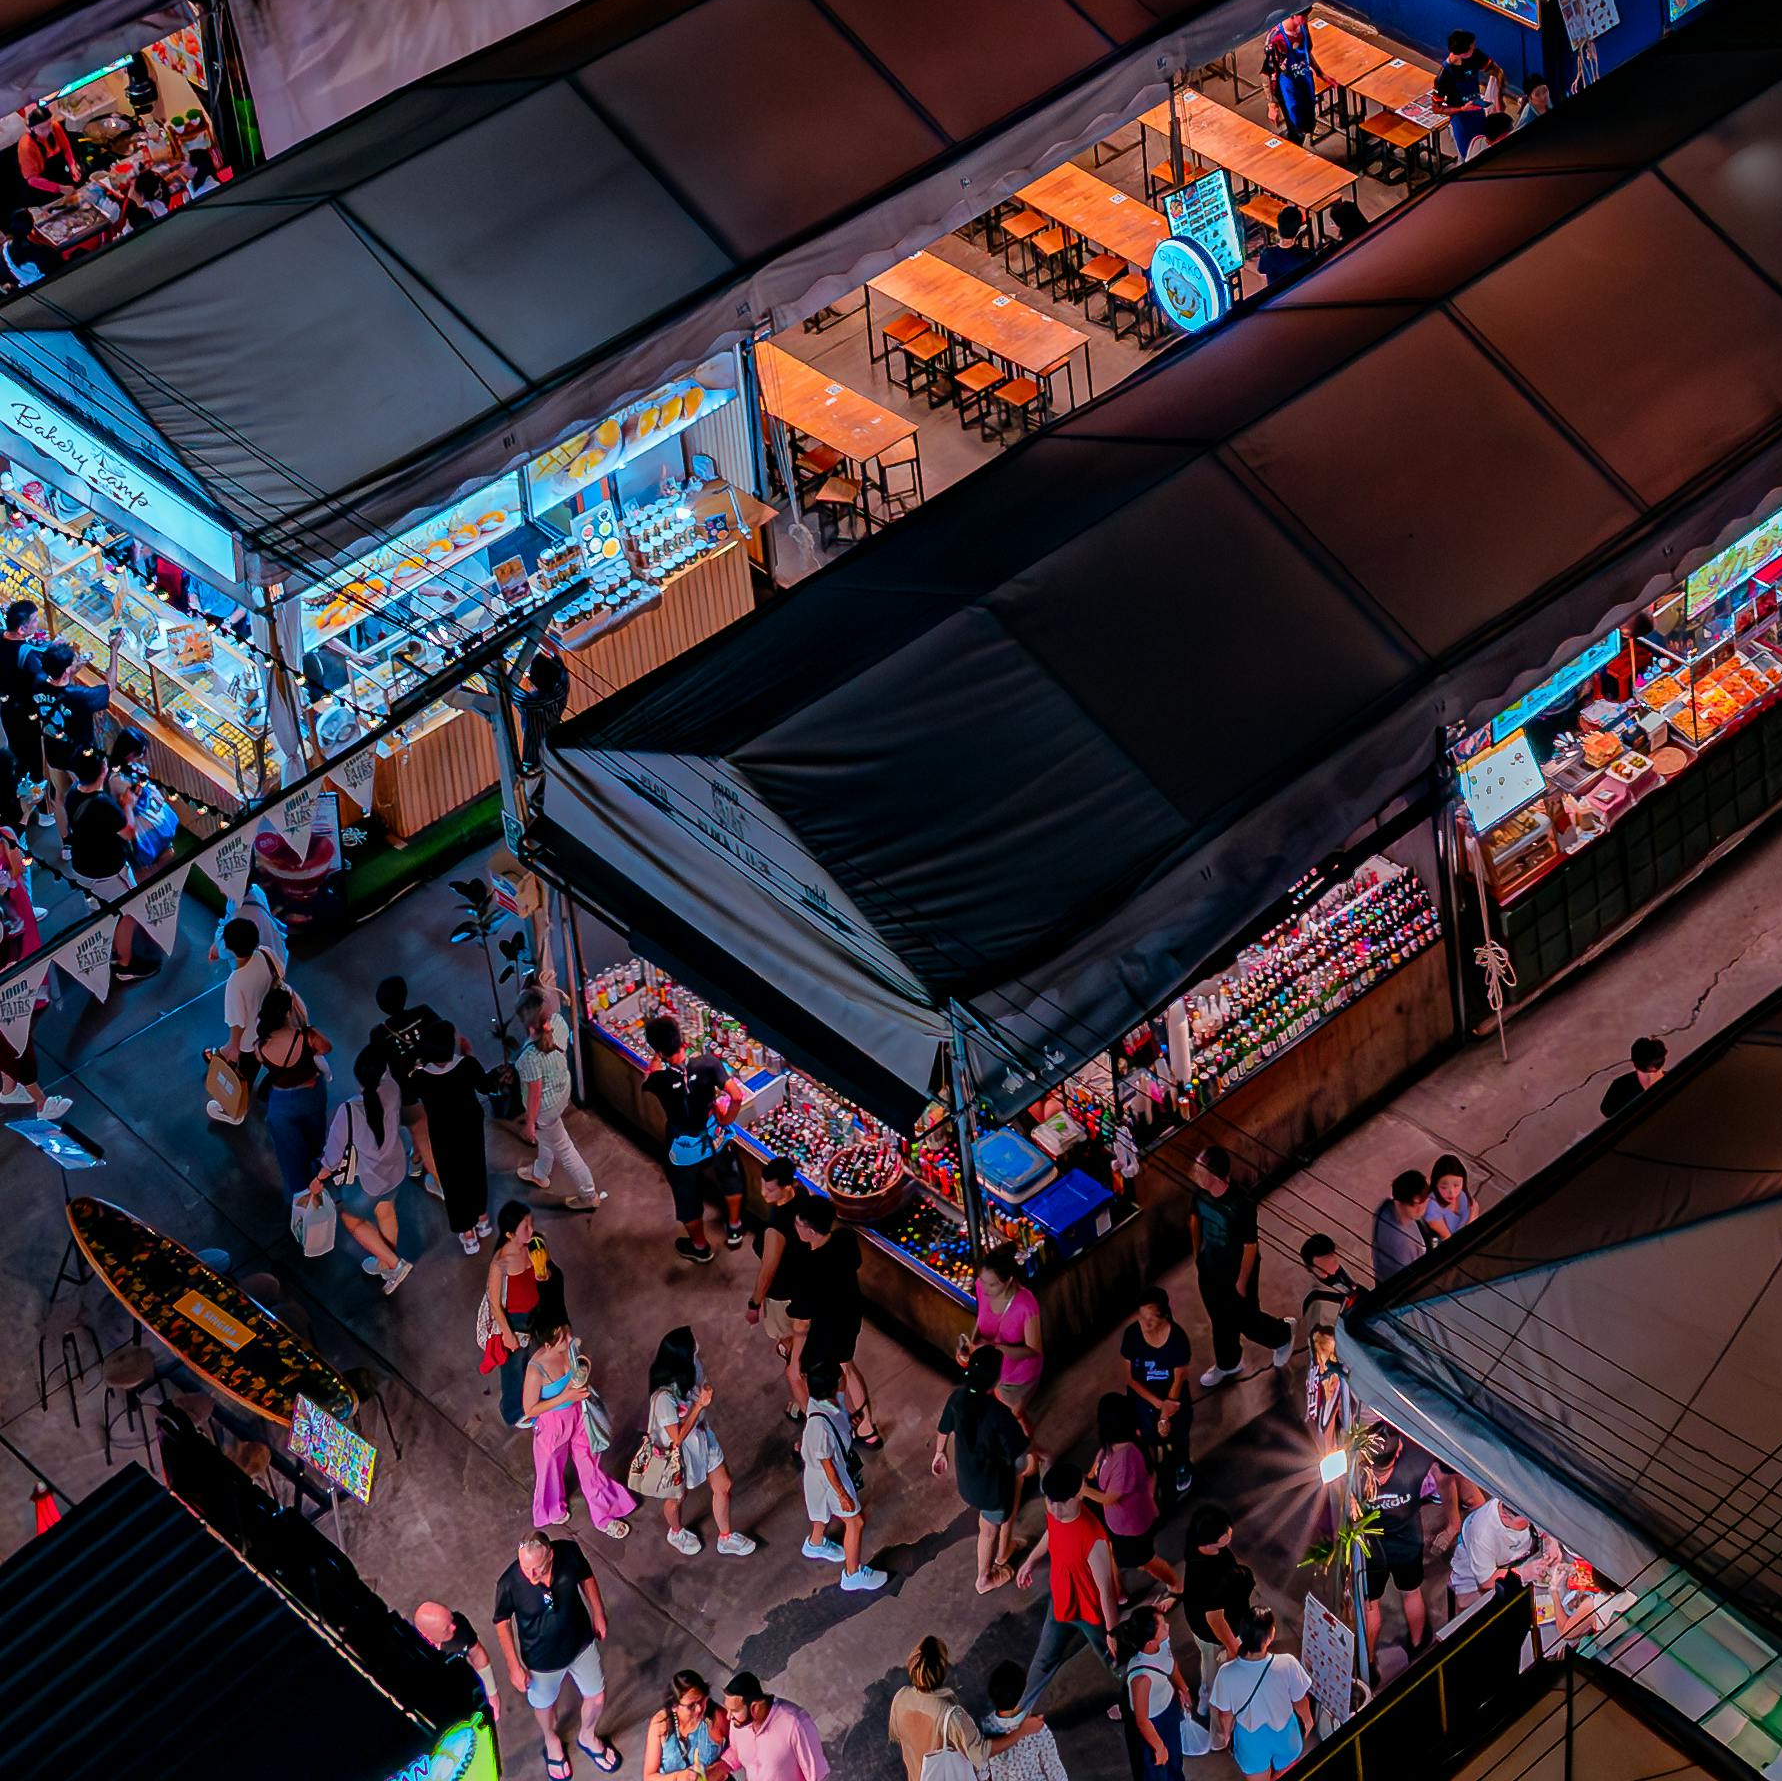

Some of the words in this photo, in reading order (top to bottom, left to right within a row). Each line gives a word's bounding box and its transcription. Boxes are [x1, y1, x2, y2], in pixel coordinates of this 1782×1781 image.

[1158, 249, 1203, 280] GINTAKO
[11, 403, 89, 473] Bakery
[283, 807, 312, 826] FAIRS
[215, 853, 248, 872] FAIRS
[144, 901, 177, 920] FAIRS
[76, 930, 103, 955] JODD
[75, 947, 109, 970] FAIRS
[0, 998, 32, 1018] FAIRS
